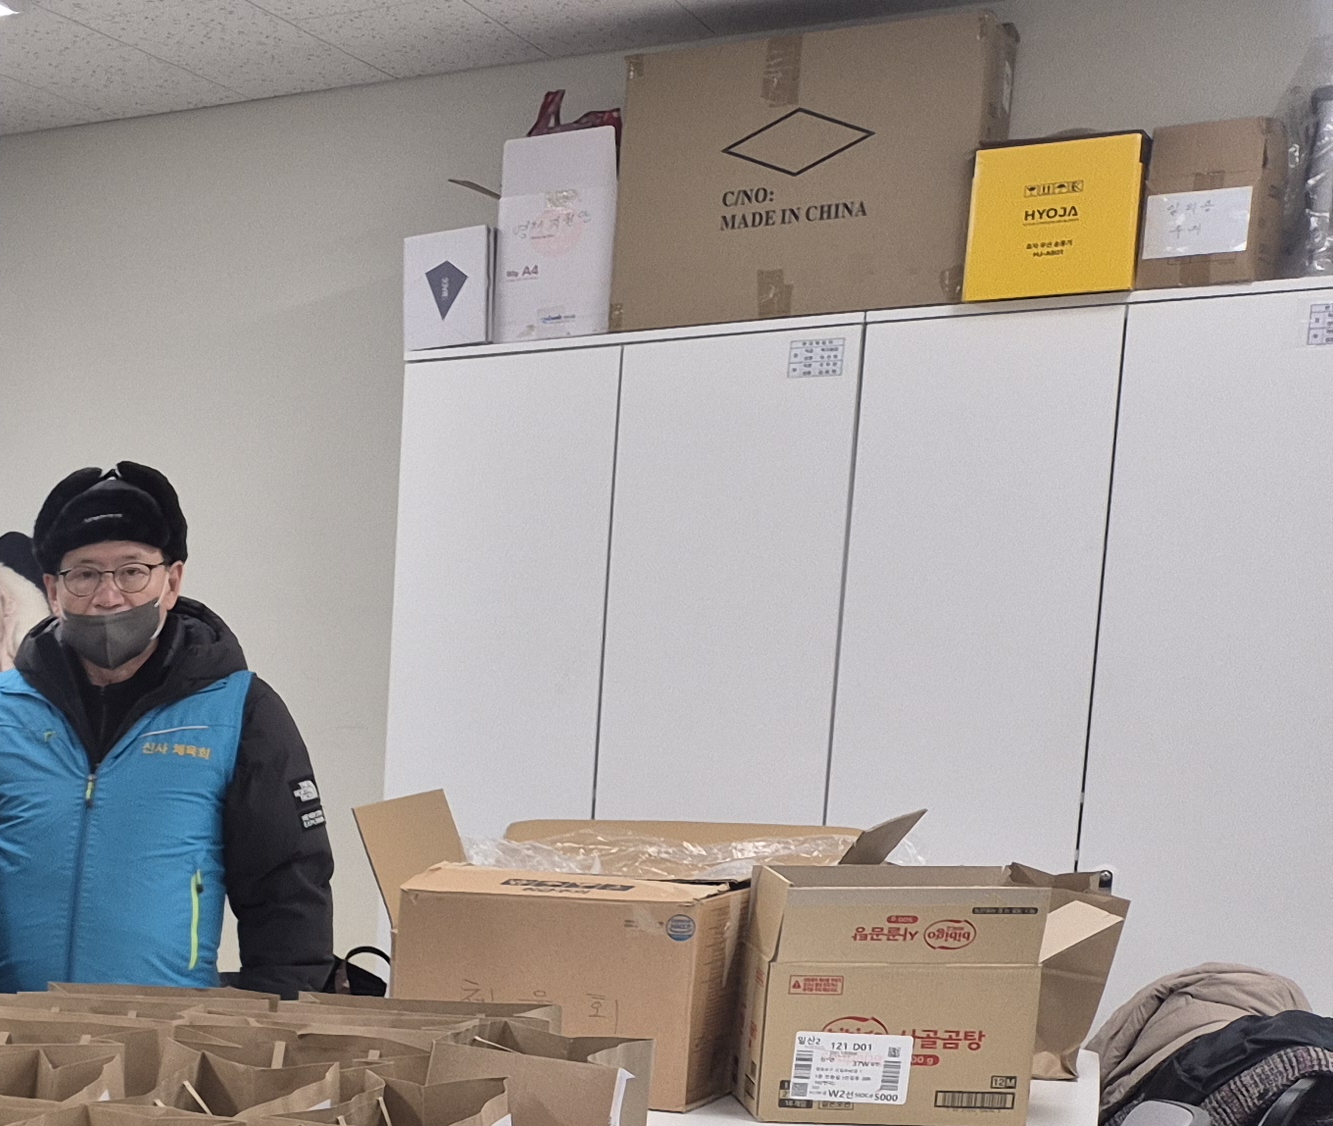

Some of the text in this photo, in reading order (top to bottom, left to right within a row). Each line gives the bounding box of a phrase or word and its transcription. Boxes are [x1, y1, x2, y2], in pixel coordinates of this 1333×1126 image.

[721, 187, 775, 207] C/NO:
[719, 201, 867, 232] MADE IN CHINA
[1023, 206, 1079, 222] HYOJA
[521, 264, 539, 276] A4
[141, 741, 212, 761] 신사 체육회
[851, 926, 971, 943] bibigo 사골곰탕
[797, 1035, 821, 1046] 일산2
[830, 1041, 873, 1052] 121 D01
